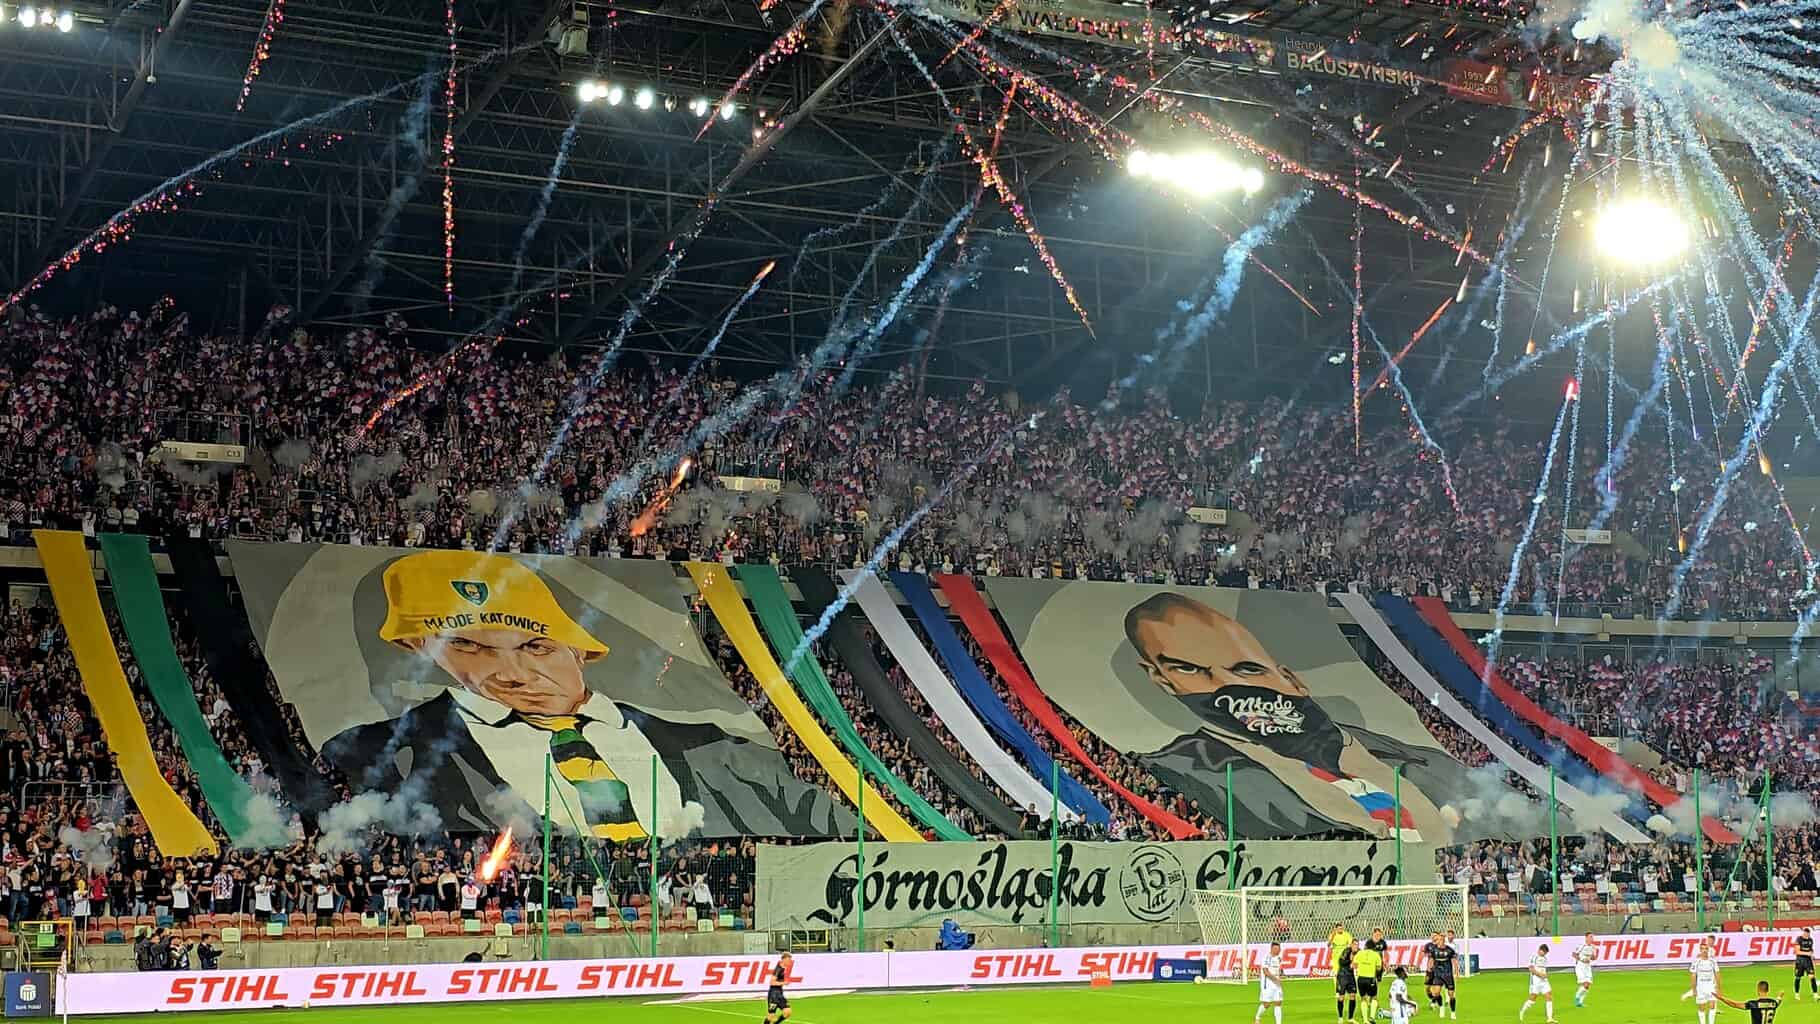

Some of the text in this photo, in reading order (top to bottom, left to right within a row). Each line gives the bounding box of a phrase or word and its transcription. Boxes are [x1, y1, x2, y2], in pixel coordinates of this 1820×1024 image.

[424, 612, 550, 635] MŁODE KATOWICE
[806, 842, 1111, 925] Górnośląska
[1133, 857, 1166, 893] 15
[166, 975, 288, 1004] STIHL
[309, 971, 426, 999] STIHL
[447, 967, 558, 995] STIHL
[577, 963, 683, 990] STIHL
[970, 954, 1062, 978] STIHL
